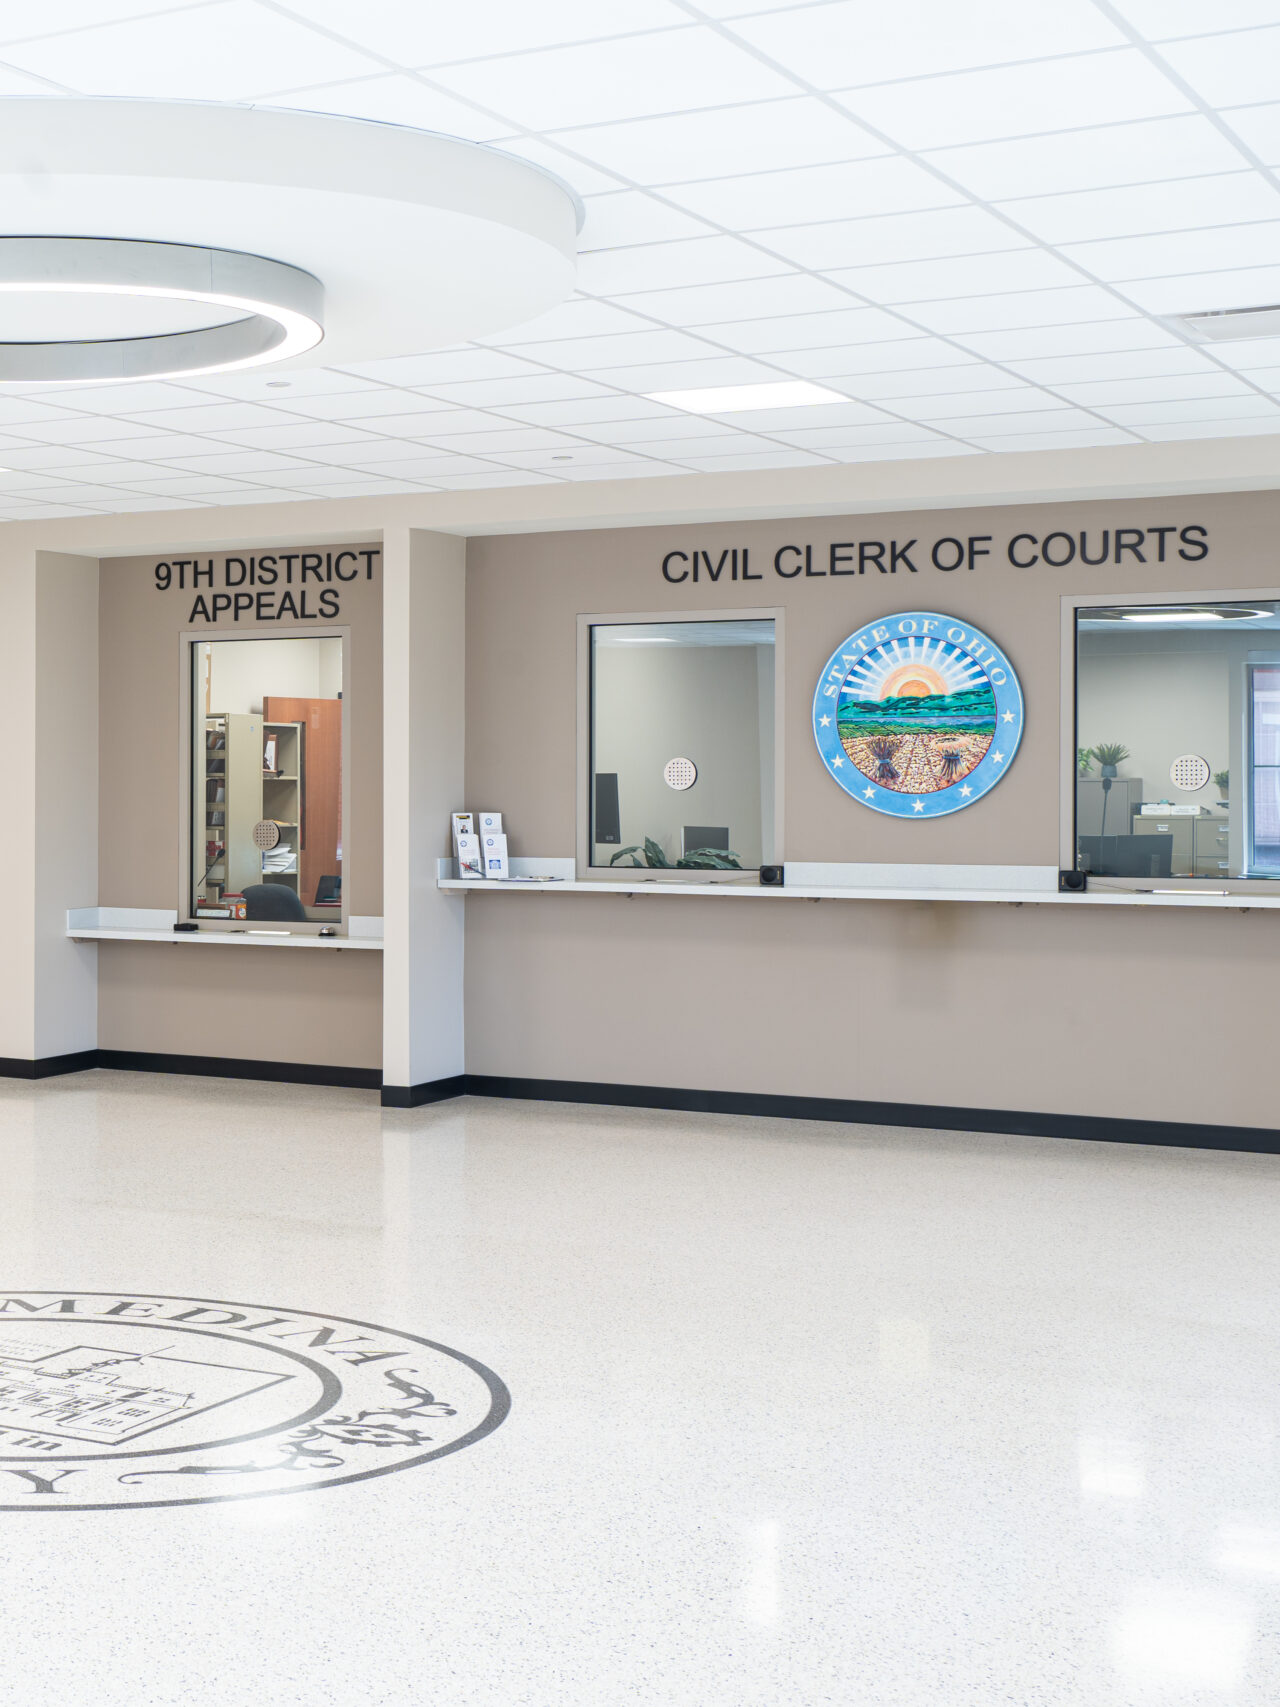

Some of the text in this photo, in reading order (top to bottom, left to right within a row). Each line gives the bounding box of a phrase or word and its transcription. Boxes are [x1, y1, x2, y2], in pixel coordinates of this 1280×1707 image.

[154, 549, 381, 591] 9TH DISTRICT
[661, 525, 1210, 584] CIVIL CLERK OF COURTS
[188, 588, 340, 624] APPEALS
[822, 618, 1008, 699] STATE OF OHIO
[10, 1433, 64, 1452] in
